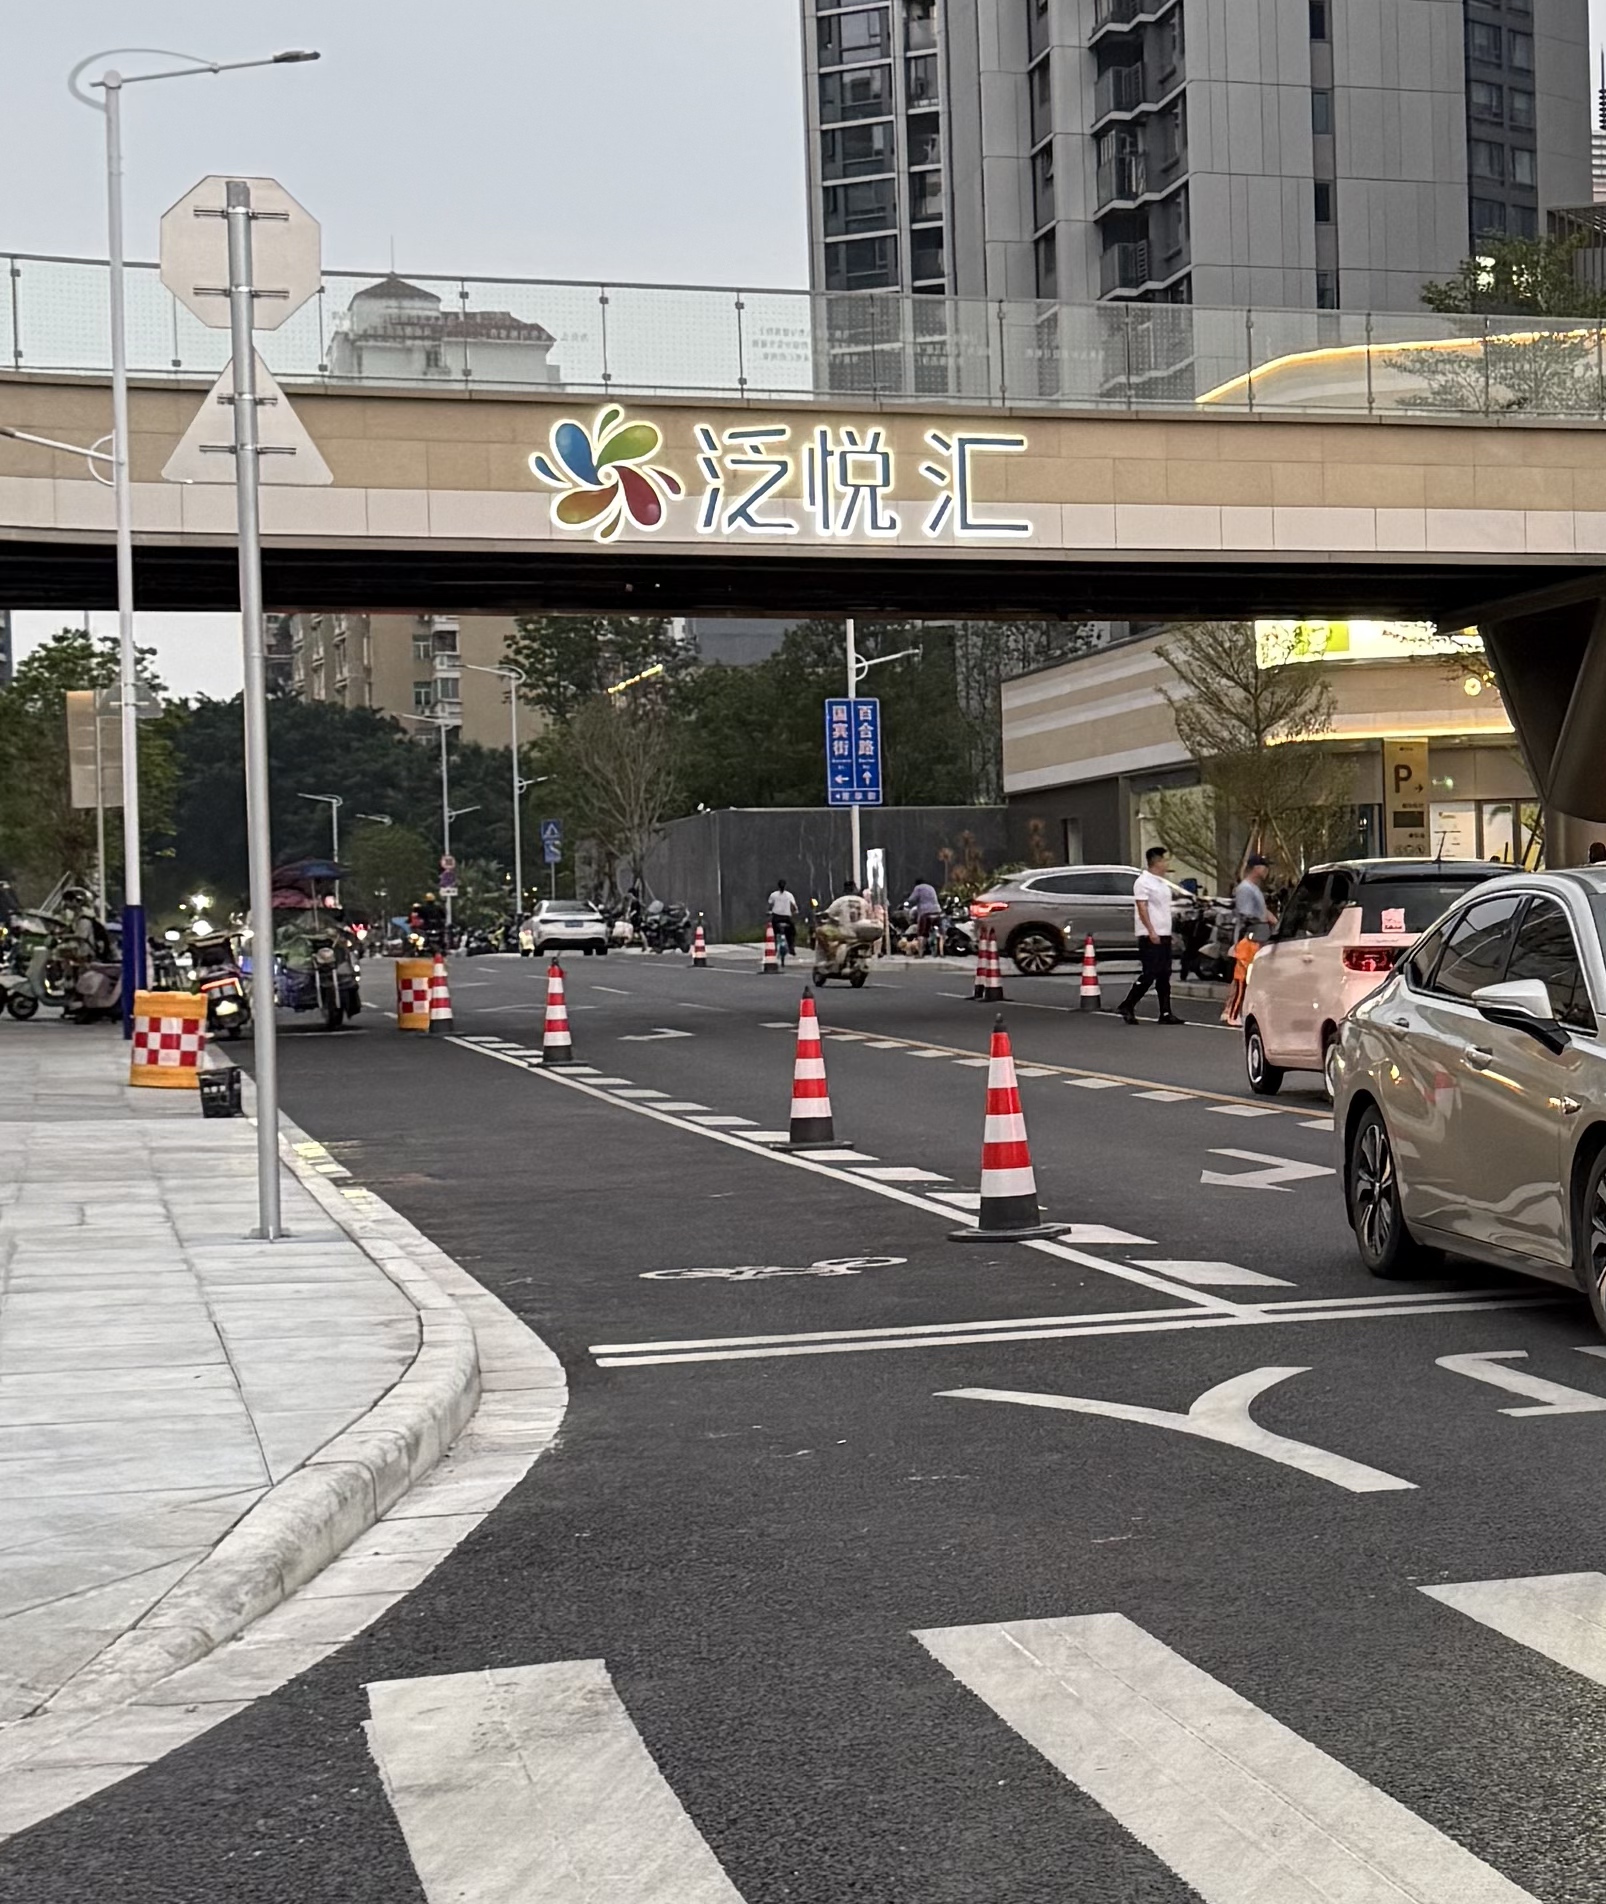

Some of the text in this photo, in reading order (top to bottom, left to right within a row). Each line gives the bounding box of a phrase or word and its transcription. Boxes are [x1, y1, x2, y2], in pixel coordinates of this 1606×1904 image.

[697, 424, 1033, 534] 泛悦汇
[857, 705, 875, 756] 百合路
[1393, 763, 1413, 794] P
